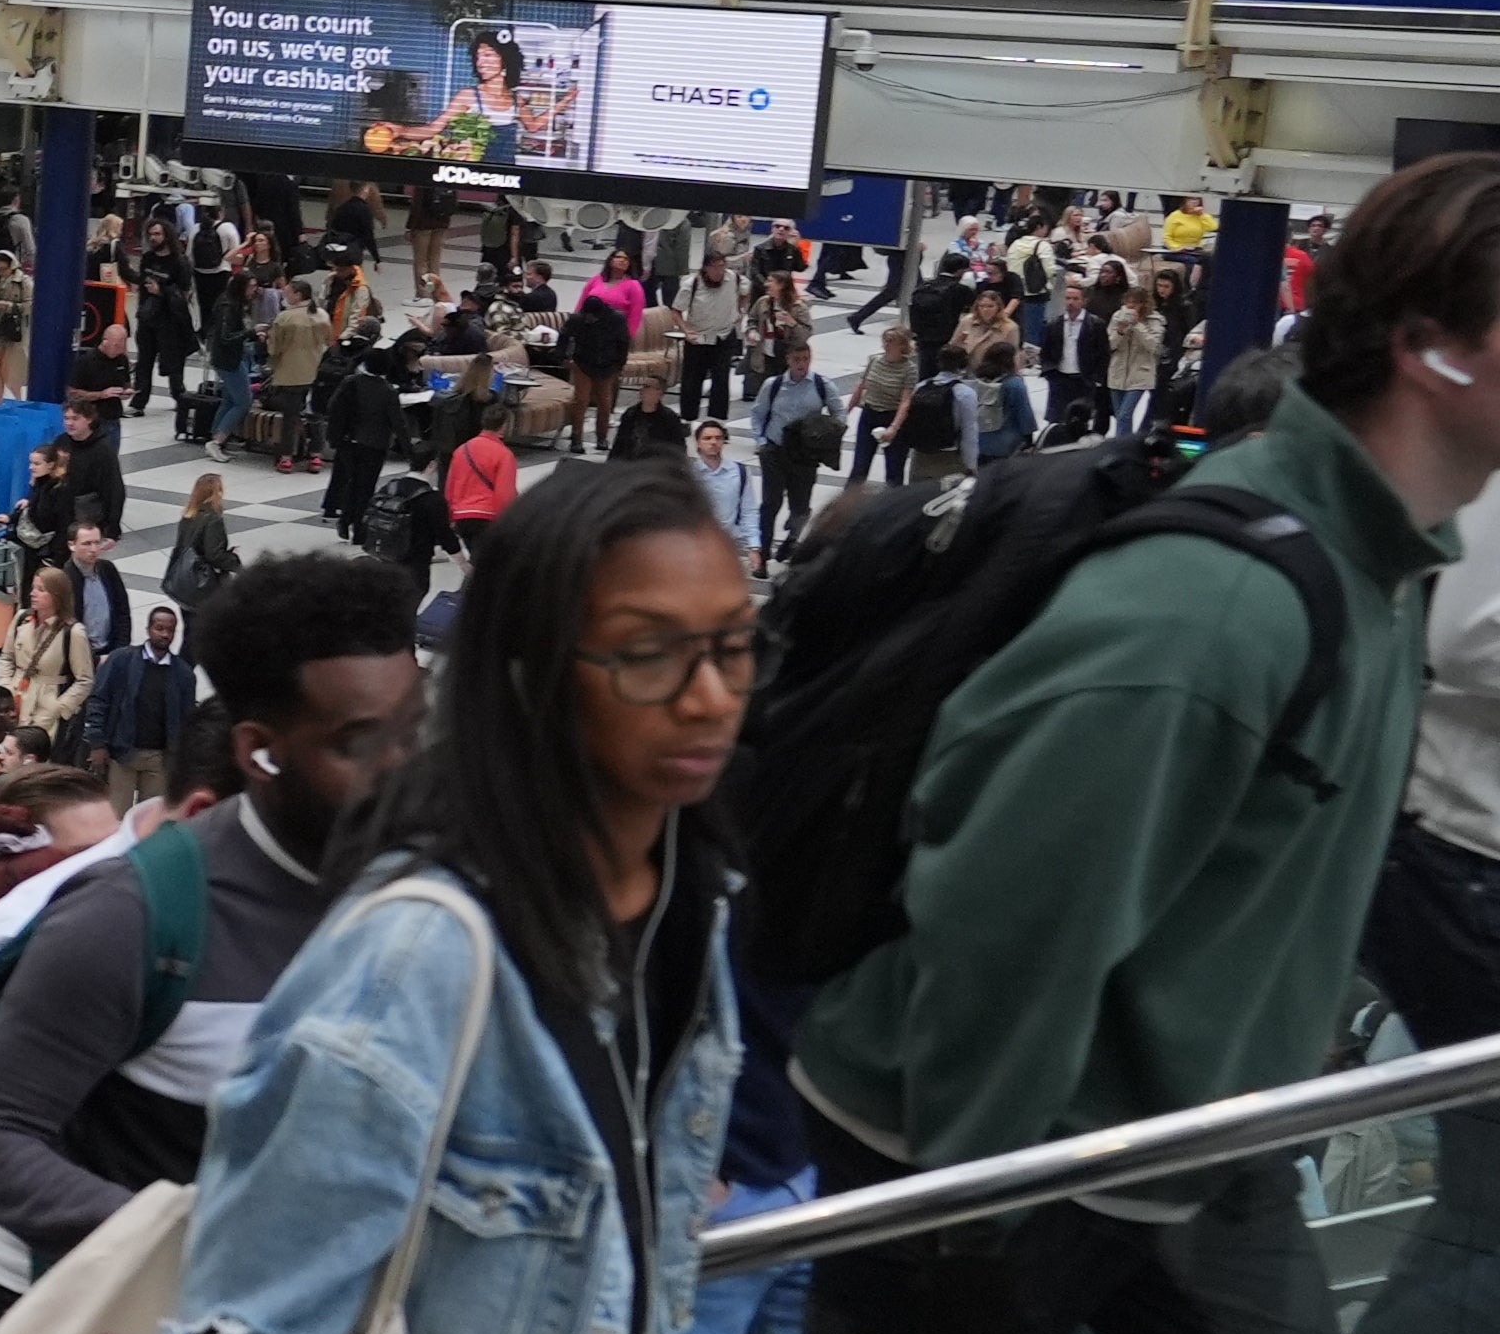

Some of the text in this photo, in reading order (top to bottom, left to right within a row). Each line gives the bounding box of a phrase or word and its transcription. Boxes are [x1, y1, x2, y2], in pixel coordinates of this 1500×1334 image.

[208, 5, 373, 36] You can count
[207, 37, 392, 70] on us, we've got
[203, 65, 372, 94] your cashback
[652, 84, 742, 107] CHASE
[433, 166, 521, 191] JCDecaux
